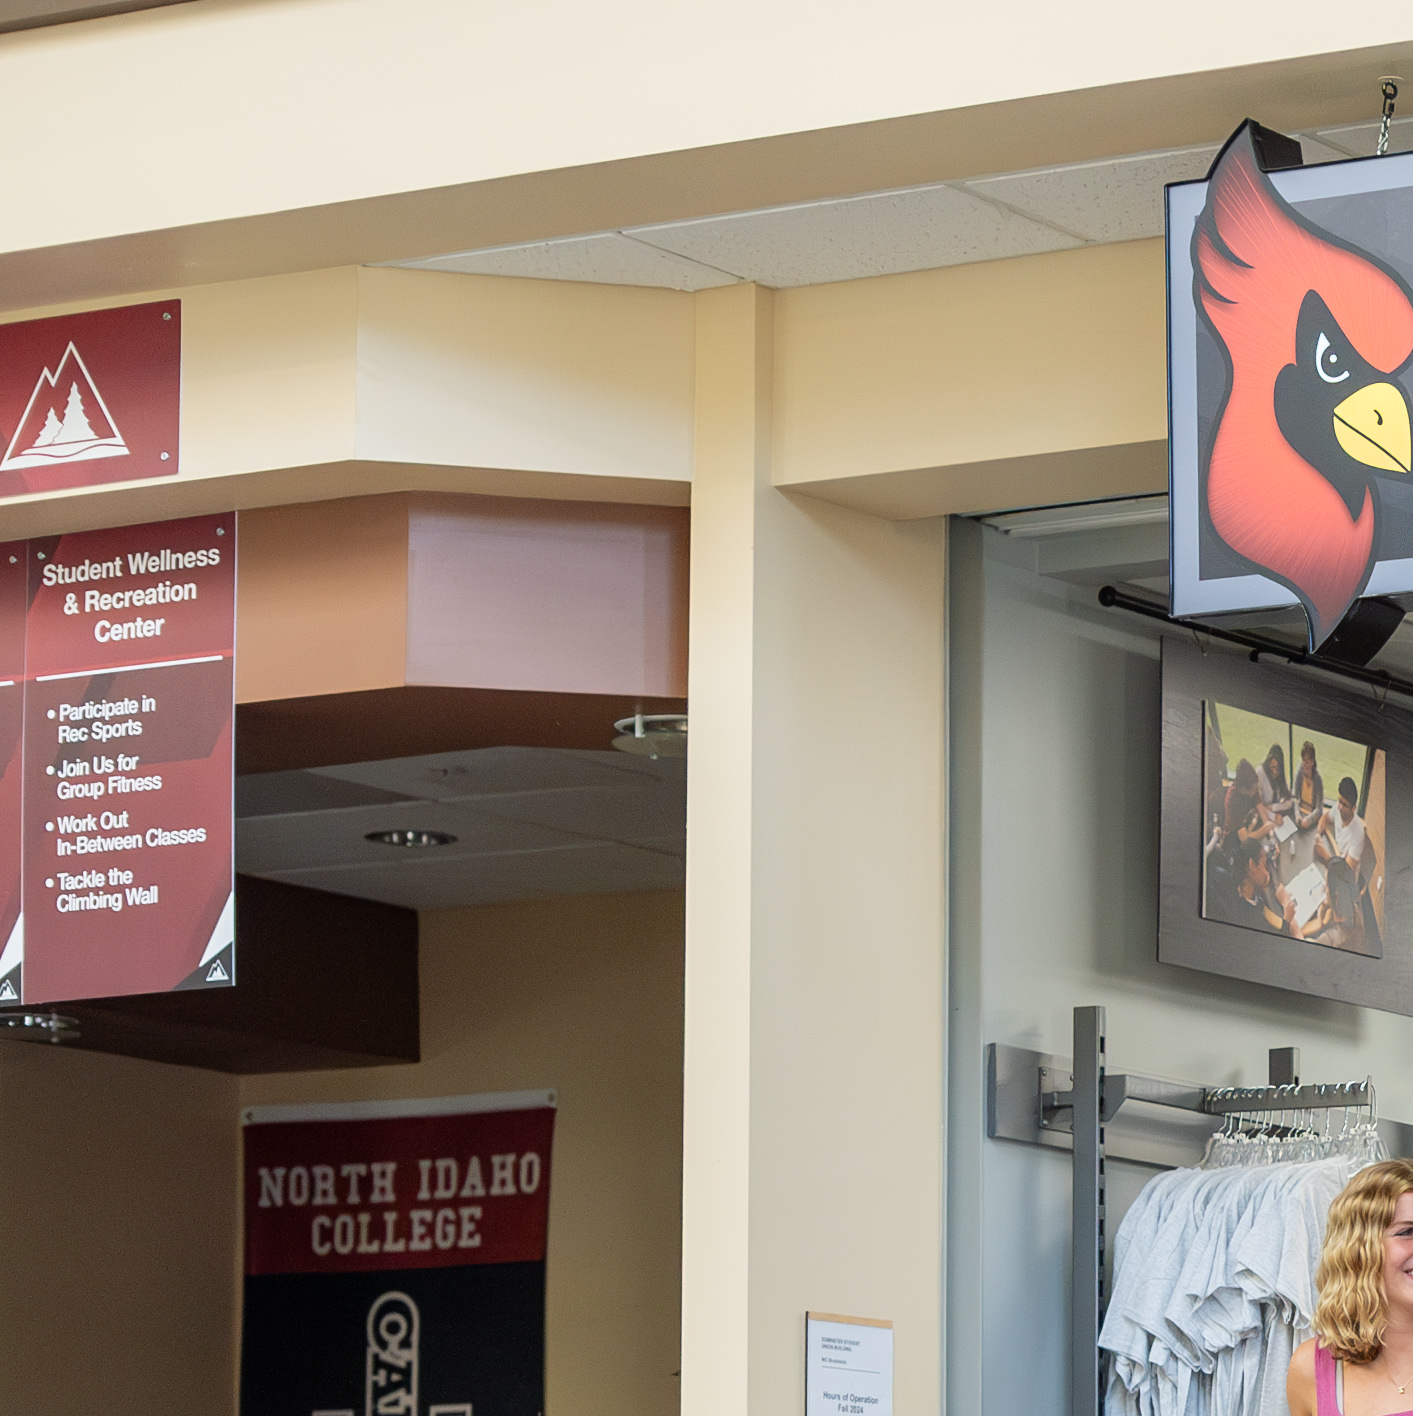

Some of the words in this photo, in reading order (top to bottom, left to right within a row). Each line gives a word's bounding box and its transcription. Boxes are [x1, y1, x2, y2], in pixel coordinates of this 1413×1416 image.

[42, 557, 123, 586] Student
[128, 549, 220, 574] Wellness
[63, 593, 80, 616] &
[84, 581, 197, 612] Recreation
[94, 618, 165, 642] Center
[59, 697, 138, 722] Participate
[142, 695, 156, 713] in
[58, 726, 88, 743] Rec
[91, 720, 142, 742] Sports
[57, 759, 89, 778] Join
[93, 756, 114, 774] Us
[117, 754, 139, 772] for
[57, 781, 104, 800] Group
[108, 775, 162, 794] Fitness
[57, 814, 97, 834] Work
[100, 811, 129, 829] Out
[57, 833, 142, 856] In-Between
[146, 827, 206, 847] Classes
[56, 870, 105, 890] Tackle
[108, 868, 134, 885] the
[56, 893, 123, 913] Climbing
[125, 886, 158, 906] Wall
[258, 1162, 397, 1207] NORTH
[416, 1152, 541, 1202] IDAHO
[312, 1207, 482, 1256] COLLEGE
[823, 1390, 840, 1400] Hours
[842, 1393, 848, 1401] of
[850, 1394, 878, 1404] Operation
[838, 1403, 848, 1412] Fall
